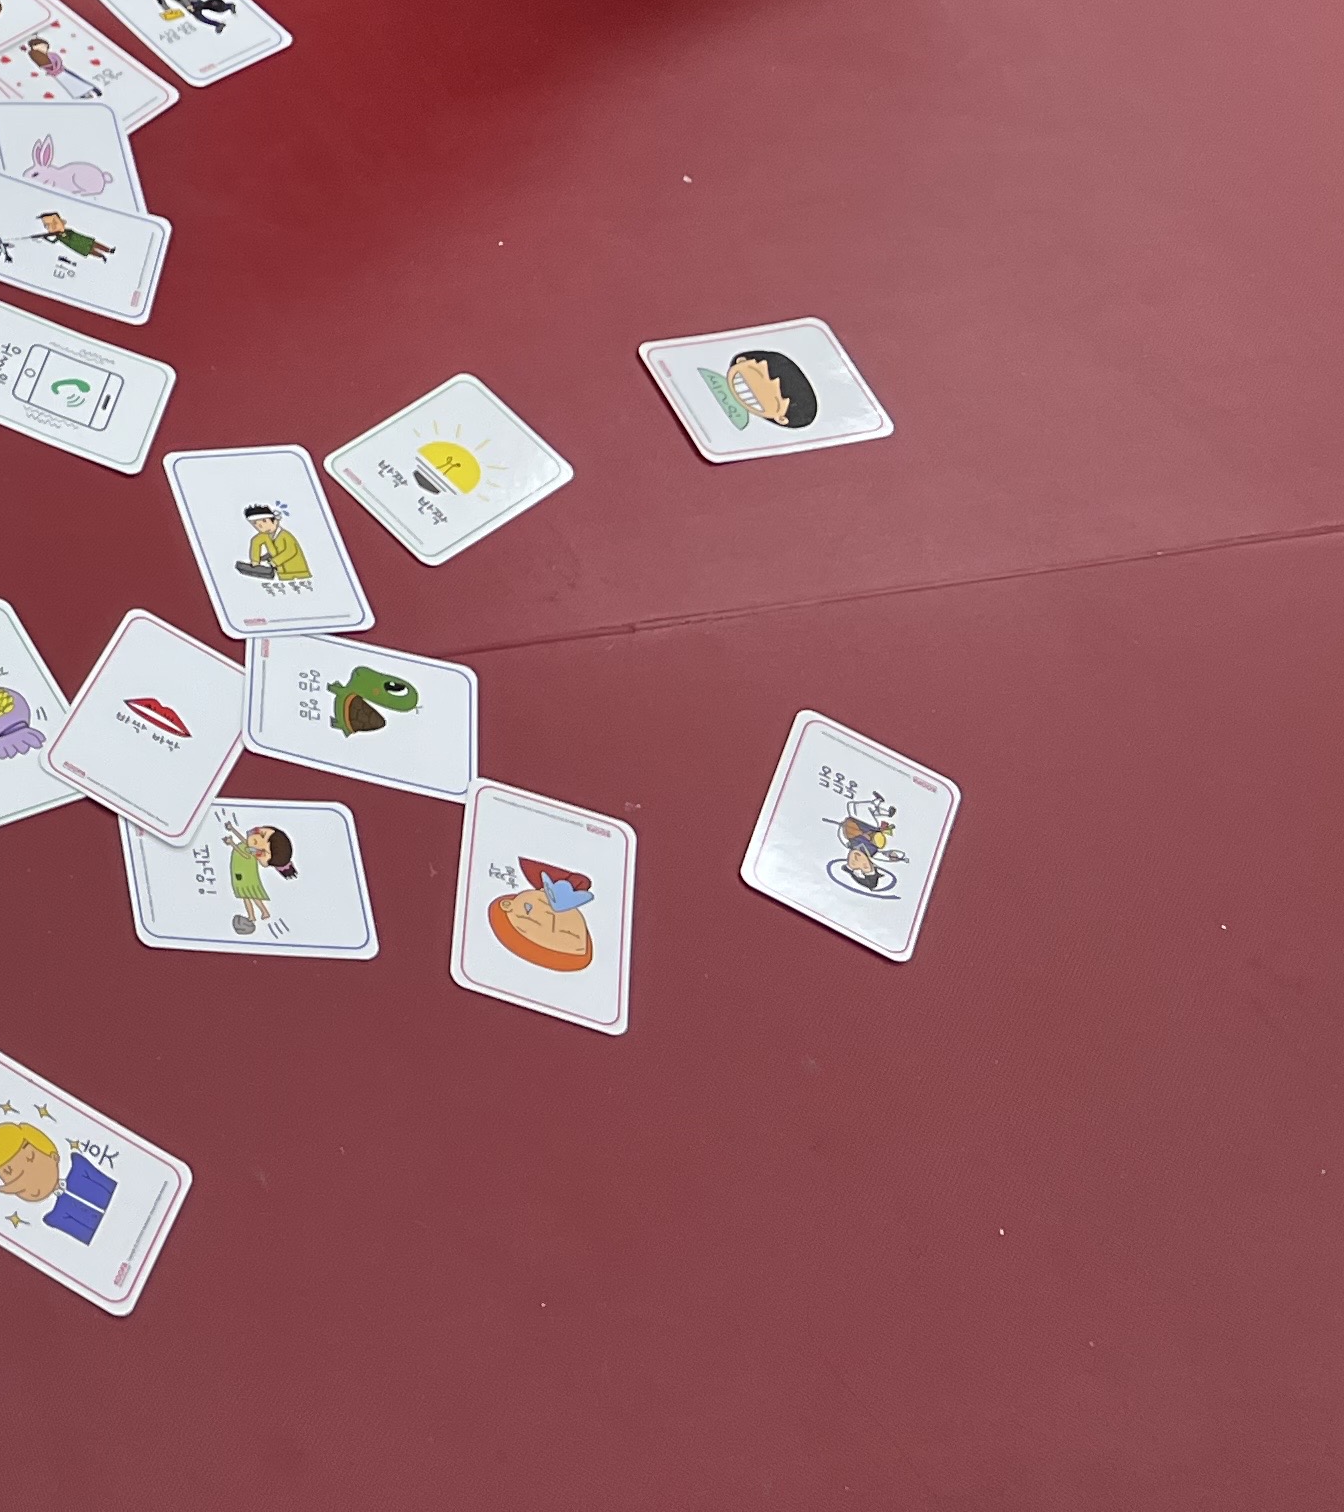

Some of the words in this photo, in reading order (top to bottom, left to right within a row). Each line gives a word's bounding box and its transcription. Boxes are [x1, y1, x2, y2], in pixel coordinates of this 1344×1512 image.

[378, 460, 407, 488] 반짝
[418, 497, 447, 525] 반짝
[299, 670, 320, 692] 엉금
[300, 699, 320, 720] 엉금
